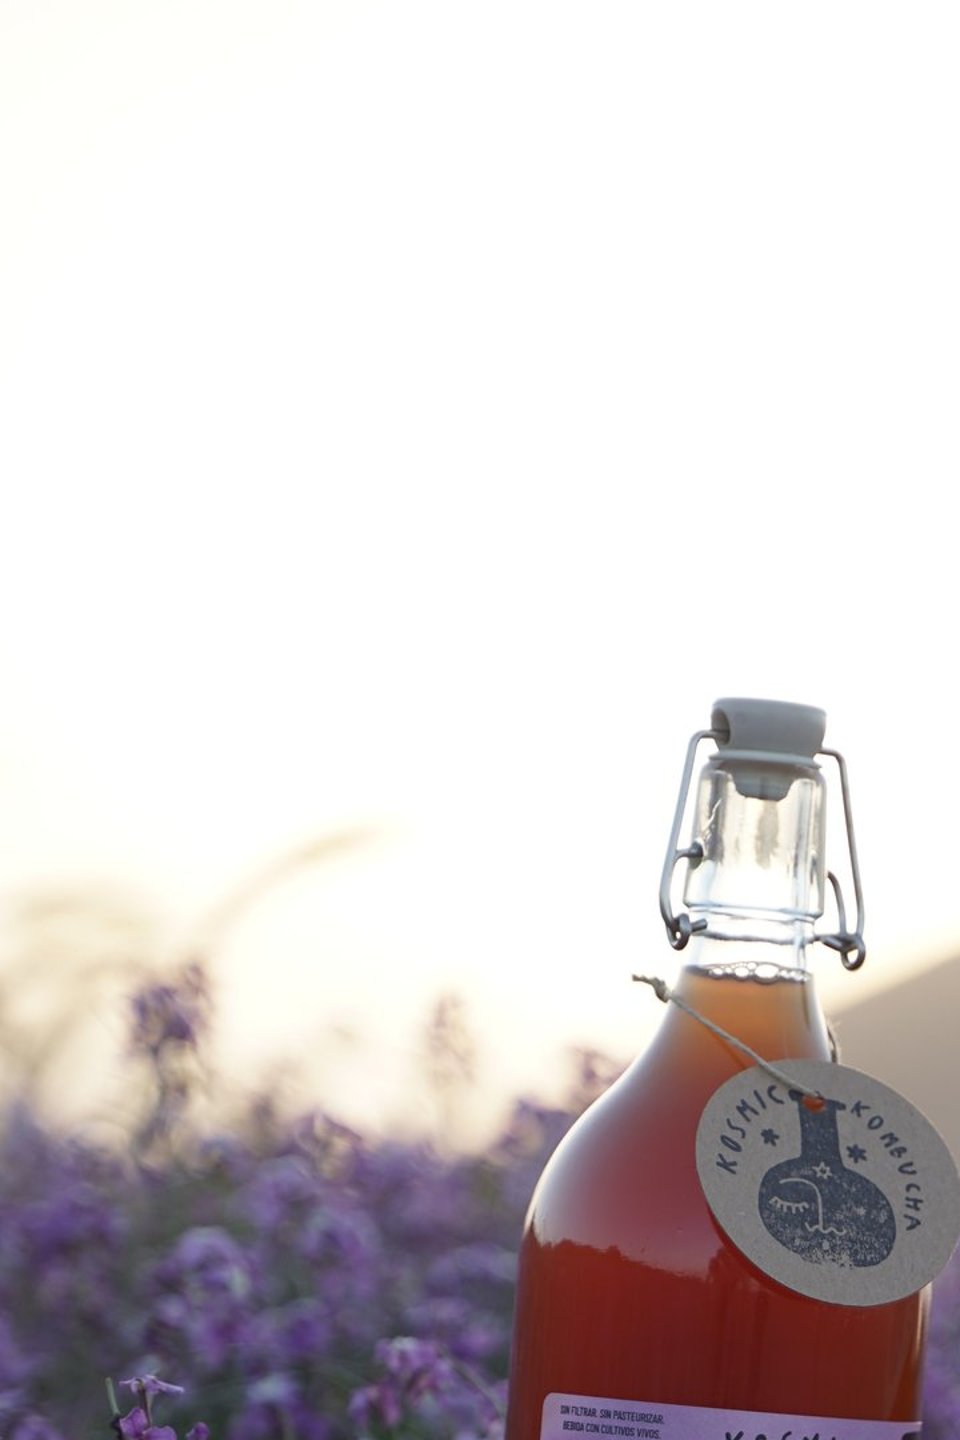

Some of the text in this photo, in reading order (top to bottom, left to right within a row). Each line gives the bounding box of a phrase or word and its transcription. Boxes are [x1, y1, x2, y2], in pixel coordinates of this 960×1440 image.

[716, 1085, 924, 1232] KOSMIC KOMBUCHA
[600, 1409, 611, 1419] SIN
[586, 1423, 599, 1433] CON
[601, 1424, 635, 1437] CULTIVOS
